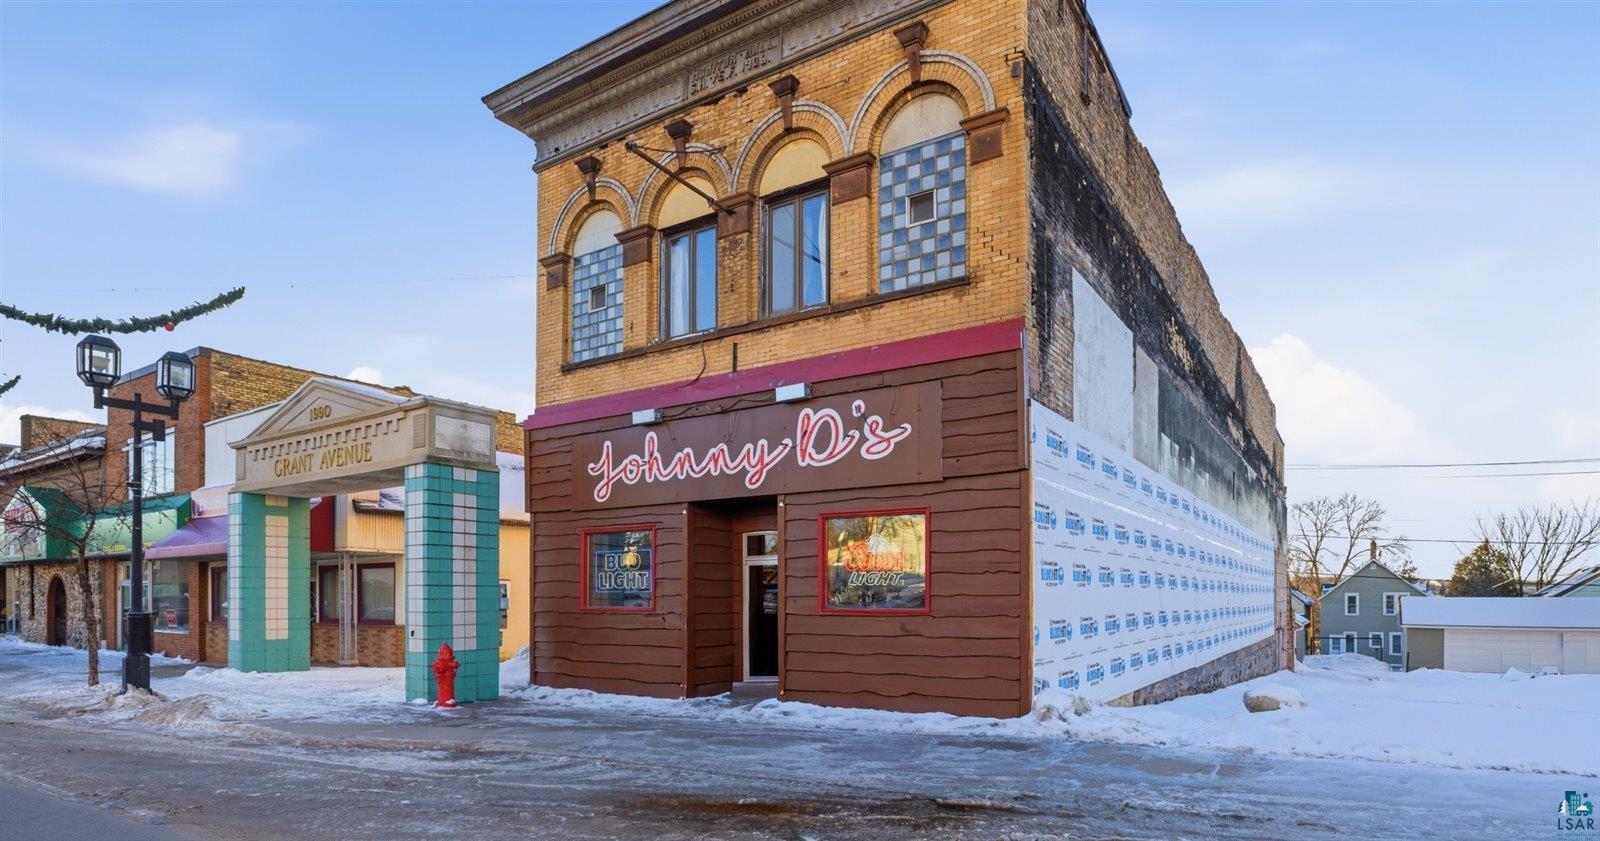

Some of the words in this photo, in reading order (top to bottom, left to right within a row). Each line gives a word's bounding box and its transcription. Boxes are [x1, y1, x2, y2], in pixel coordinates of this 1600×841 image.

[309, 404, 332, 422] 1990
[274, 453, 314, 477] GRANT
[320, 441, 373, 470] AVENUE
[588, 431, 792, 502] Johnny
[796, 400, 912, 467] D's
[605, 553, 642, 571] BUD
[599, 571, 649, 589] LIGHT
[848, 571, 905, 586] LIGHT
